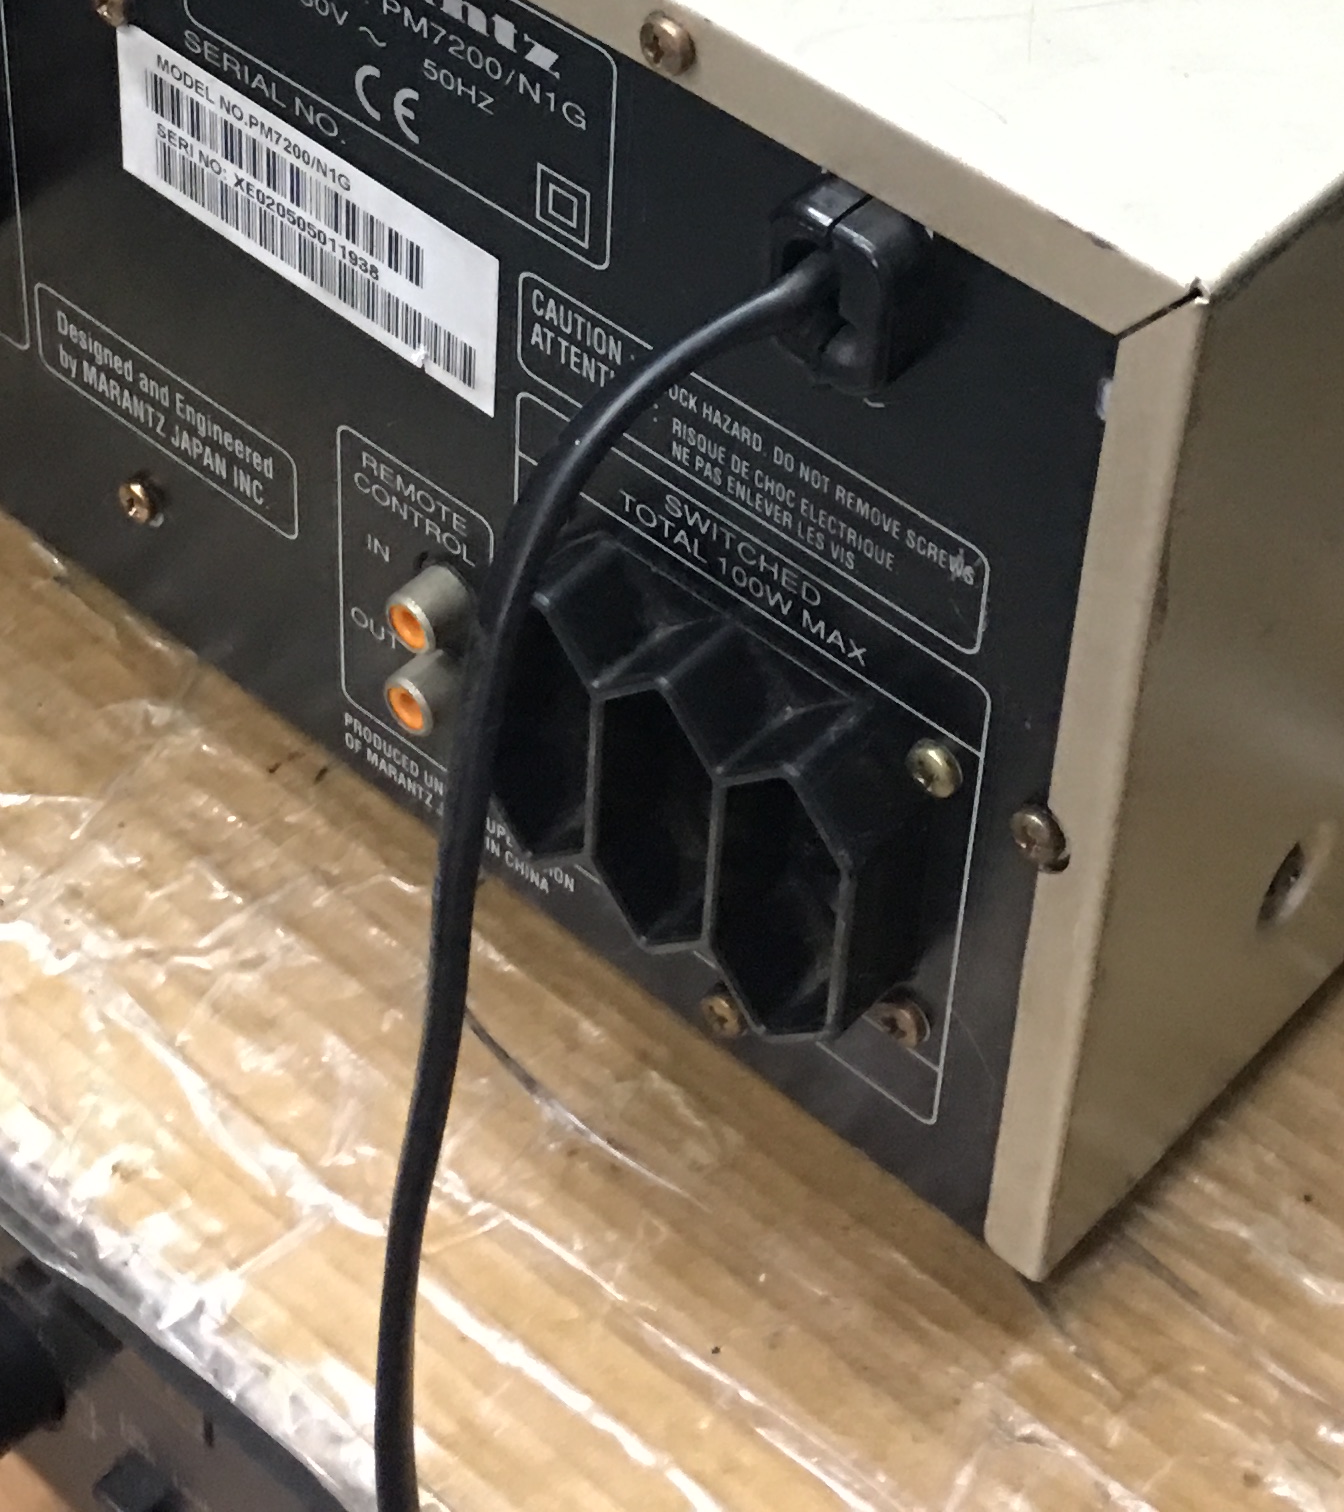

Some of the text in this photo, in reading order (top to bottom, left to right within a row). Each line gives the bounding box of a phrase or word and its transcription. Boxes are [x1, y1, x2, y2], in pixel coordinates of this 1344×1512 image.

[156, 54, 215, 104] MODEL
[184, 29, 347, 145] SERIAL NO.
[423, 58, 495, 115] 50HZ
[156, 121, 194, 159] SERI
[233, 172, 380, 282] XE020505011938
[530, 322, 616, 388] ATTENT
[532, 288, 622, 366] CAUTION
[57, 310, 274, 480] Designed and Engineered
[59, 343, 77, 379] by
[83, 360, 167, 438] MARANTZ
[170, 425, 227, 481] JAPAN
[361, 450, 468, 538] REMOTE
[671, 417, 726, 465] RISQUE
[730, 453, 751, 480] DE
[754, 469, 796, 508] CHOC
[671, 440, 856, 571] NE PAS ENLEVER LES VIS
[773, 445, 795, 473] DO
[799, 461, 830, 494] NOT
[835, 484, 901, 540] REMOVE
[353, 471, 476, 568] CONTROL
[367, 533, 390, 563] IN
[664, 493, 821, 606] SWITCHED
[619, 489, 867, 667] TOTAL 100W MAX
[344, 711, 420, 778] PRODUCED
[344, 732, 362, 754] OF
[366, 747, 433, 808] MARANTZ
[485, 836, 501, 858] IN
[505, 849, 550, 894] CHINA
